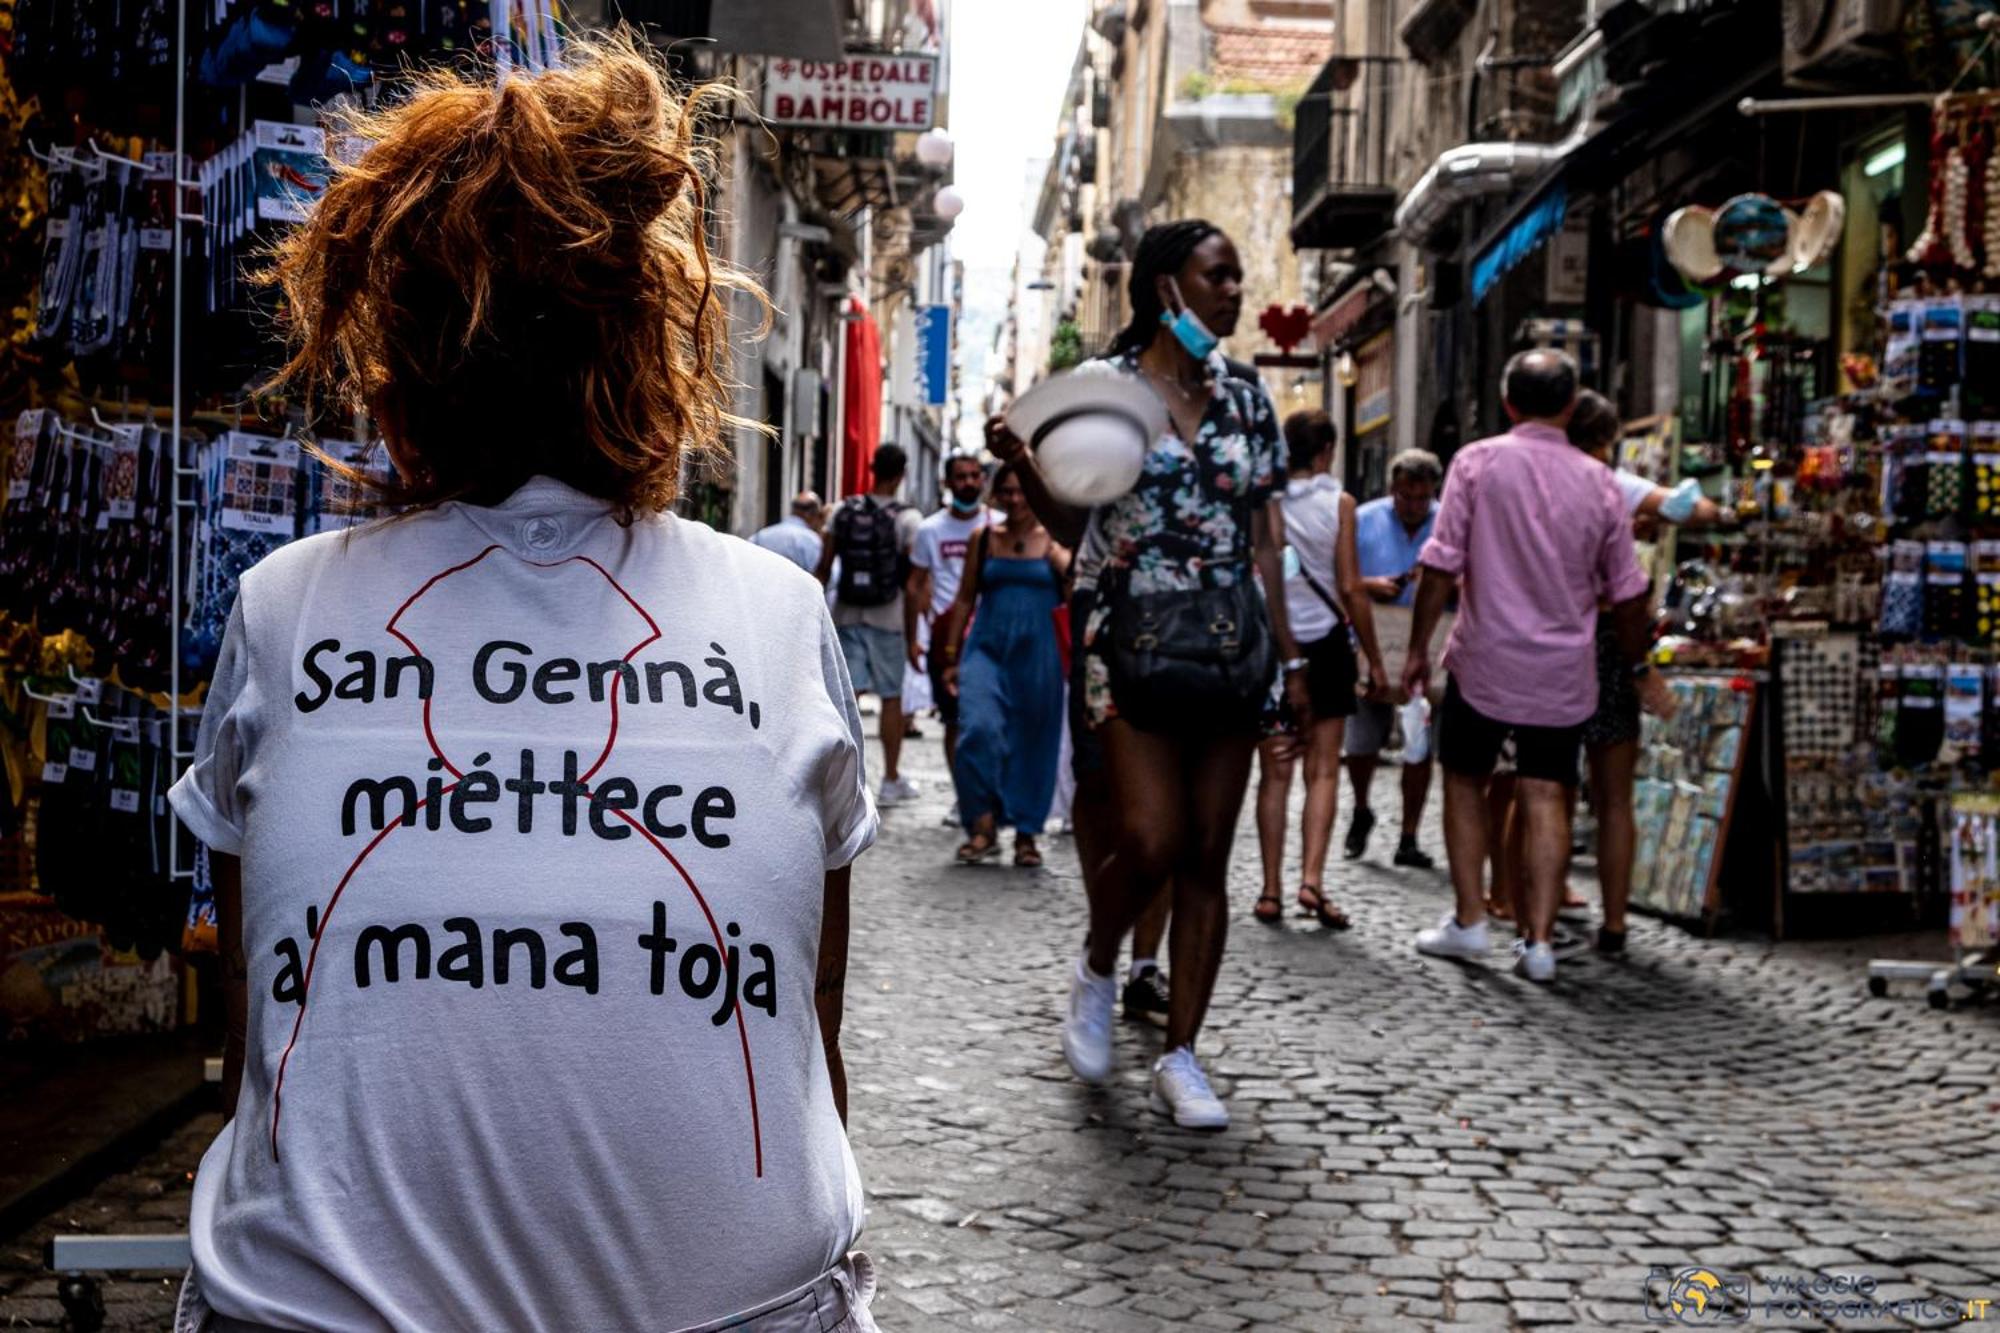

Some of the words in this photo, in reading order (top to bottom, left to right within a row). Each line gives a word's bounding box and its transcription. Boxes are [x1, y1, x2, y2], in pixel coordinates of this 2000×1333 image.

[775, 95, 928, 125] BAMBOLE
[801, 60, 931, 83] OSPEDALE
[294, 638, 435, 713] San
[472, 640, 761, 730] Gennà,
[341, 749, 737, 848] miéttece
[354, 917, 599, 995] mana
[637, 900, 778, 1026] toja
